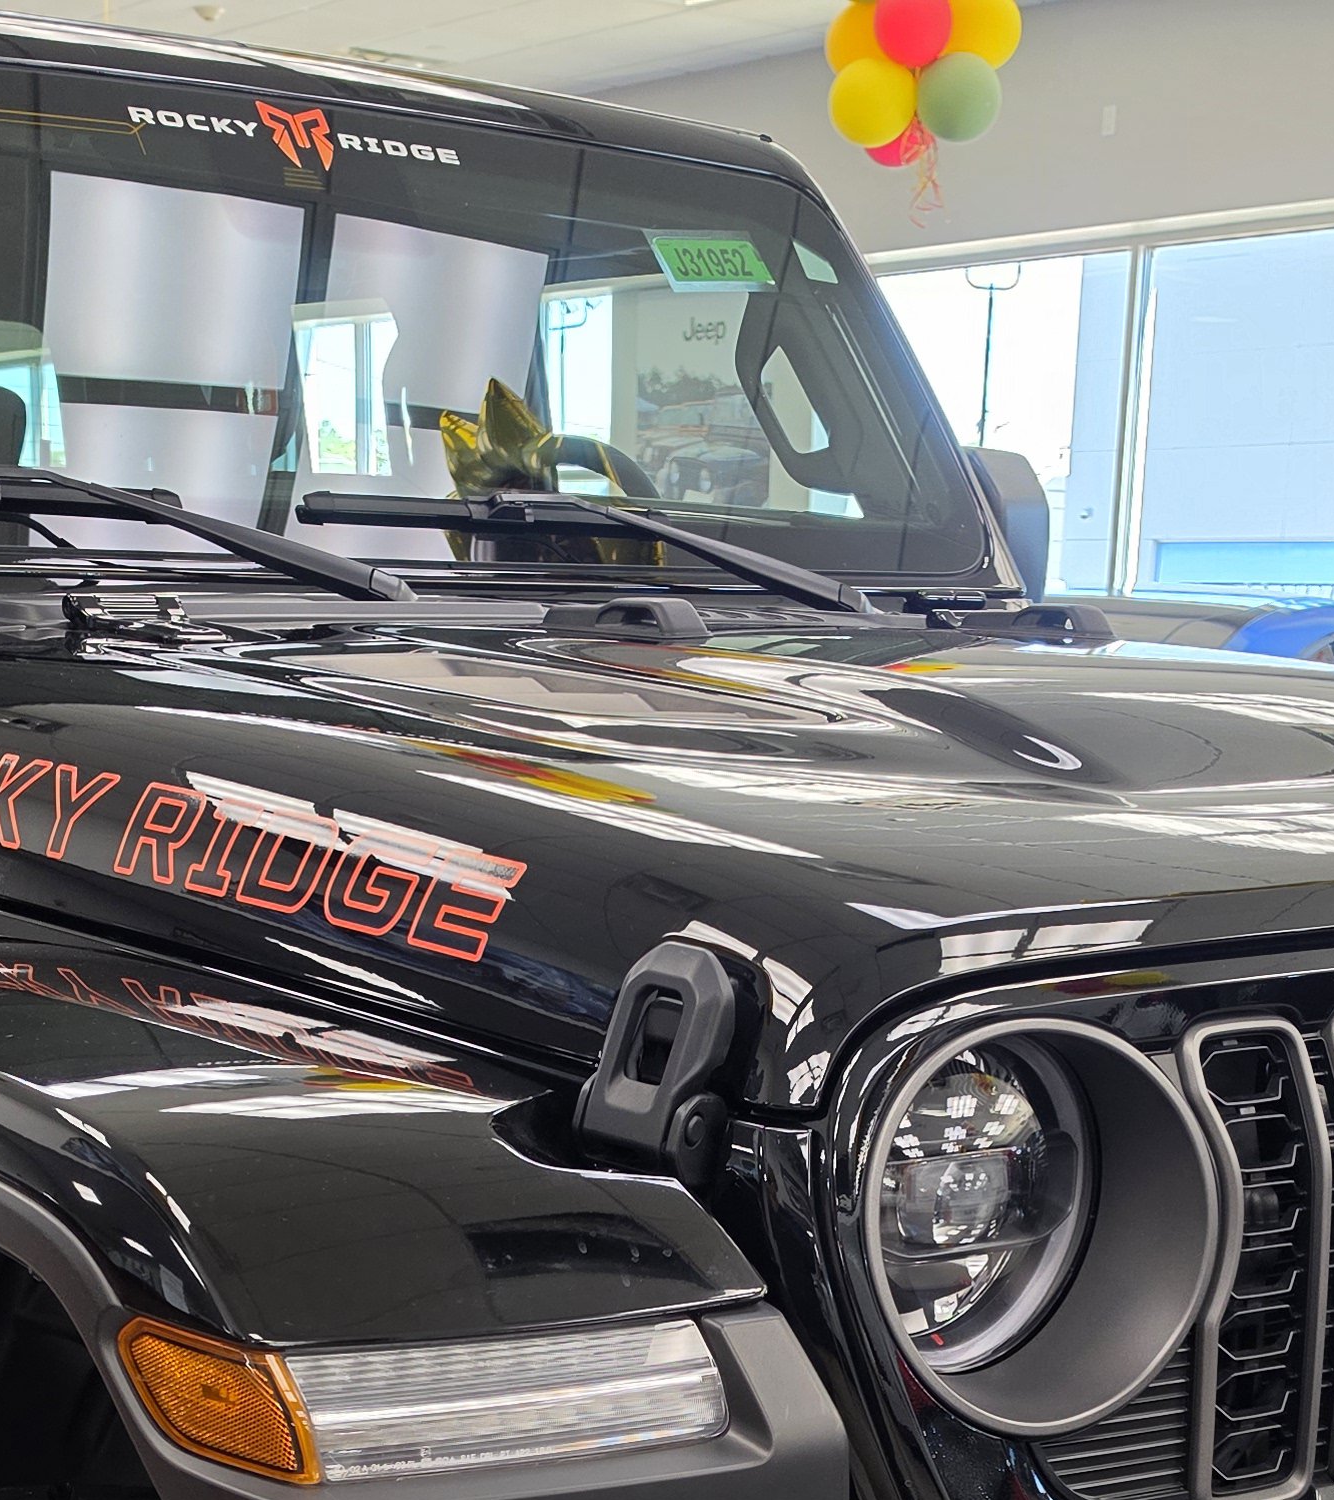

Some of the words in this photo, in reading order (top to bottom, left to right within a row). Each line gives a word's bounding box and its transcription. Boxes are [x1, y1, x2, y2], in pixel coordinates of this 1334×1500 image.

[127, 106, 258, 137] ROCKY
[336, 133, 461, 166] RIDGE
[673, 247, 754, 278] J31952
[682, 316, 728, 345] Jeep
[114, 782, 529, 963] RIDGE
